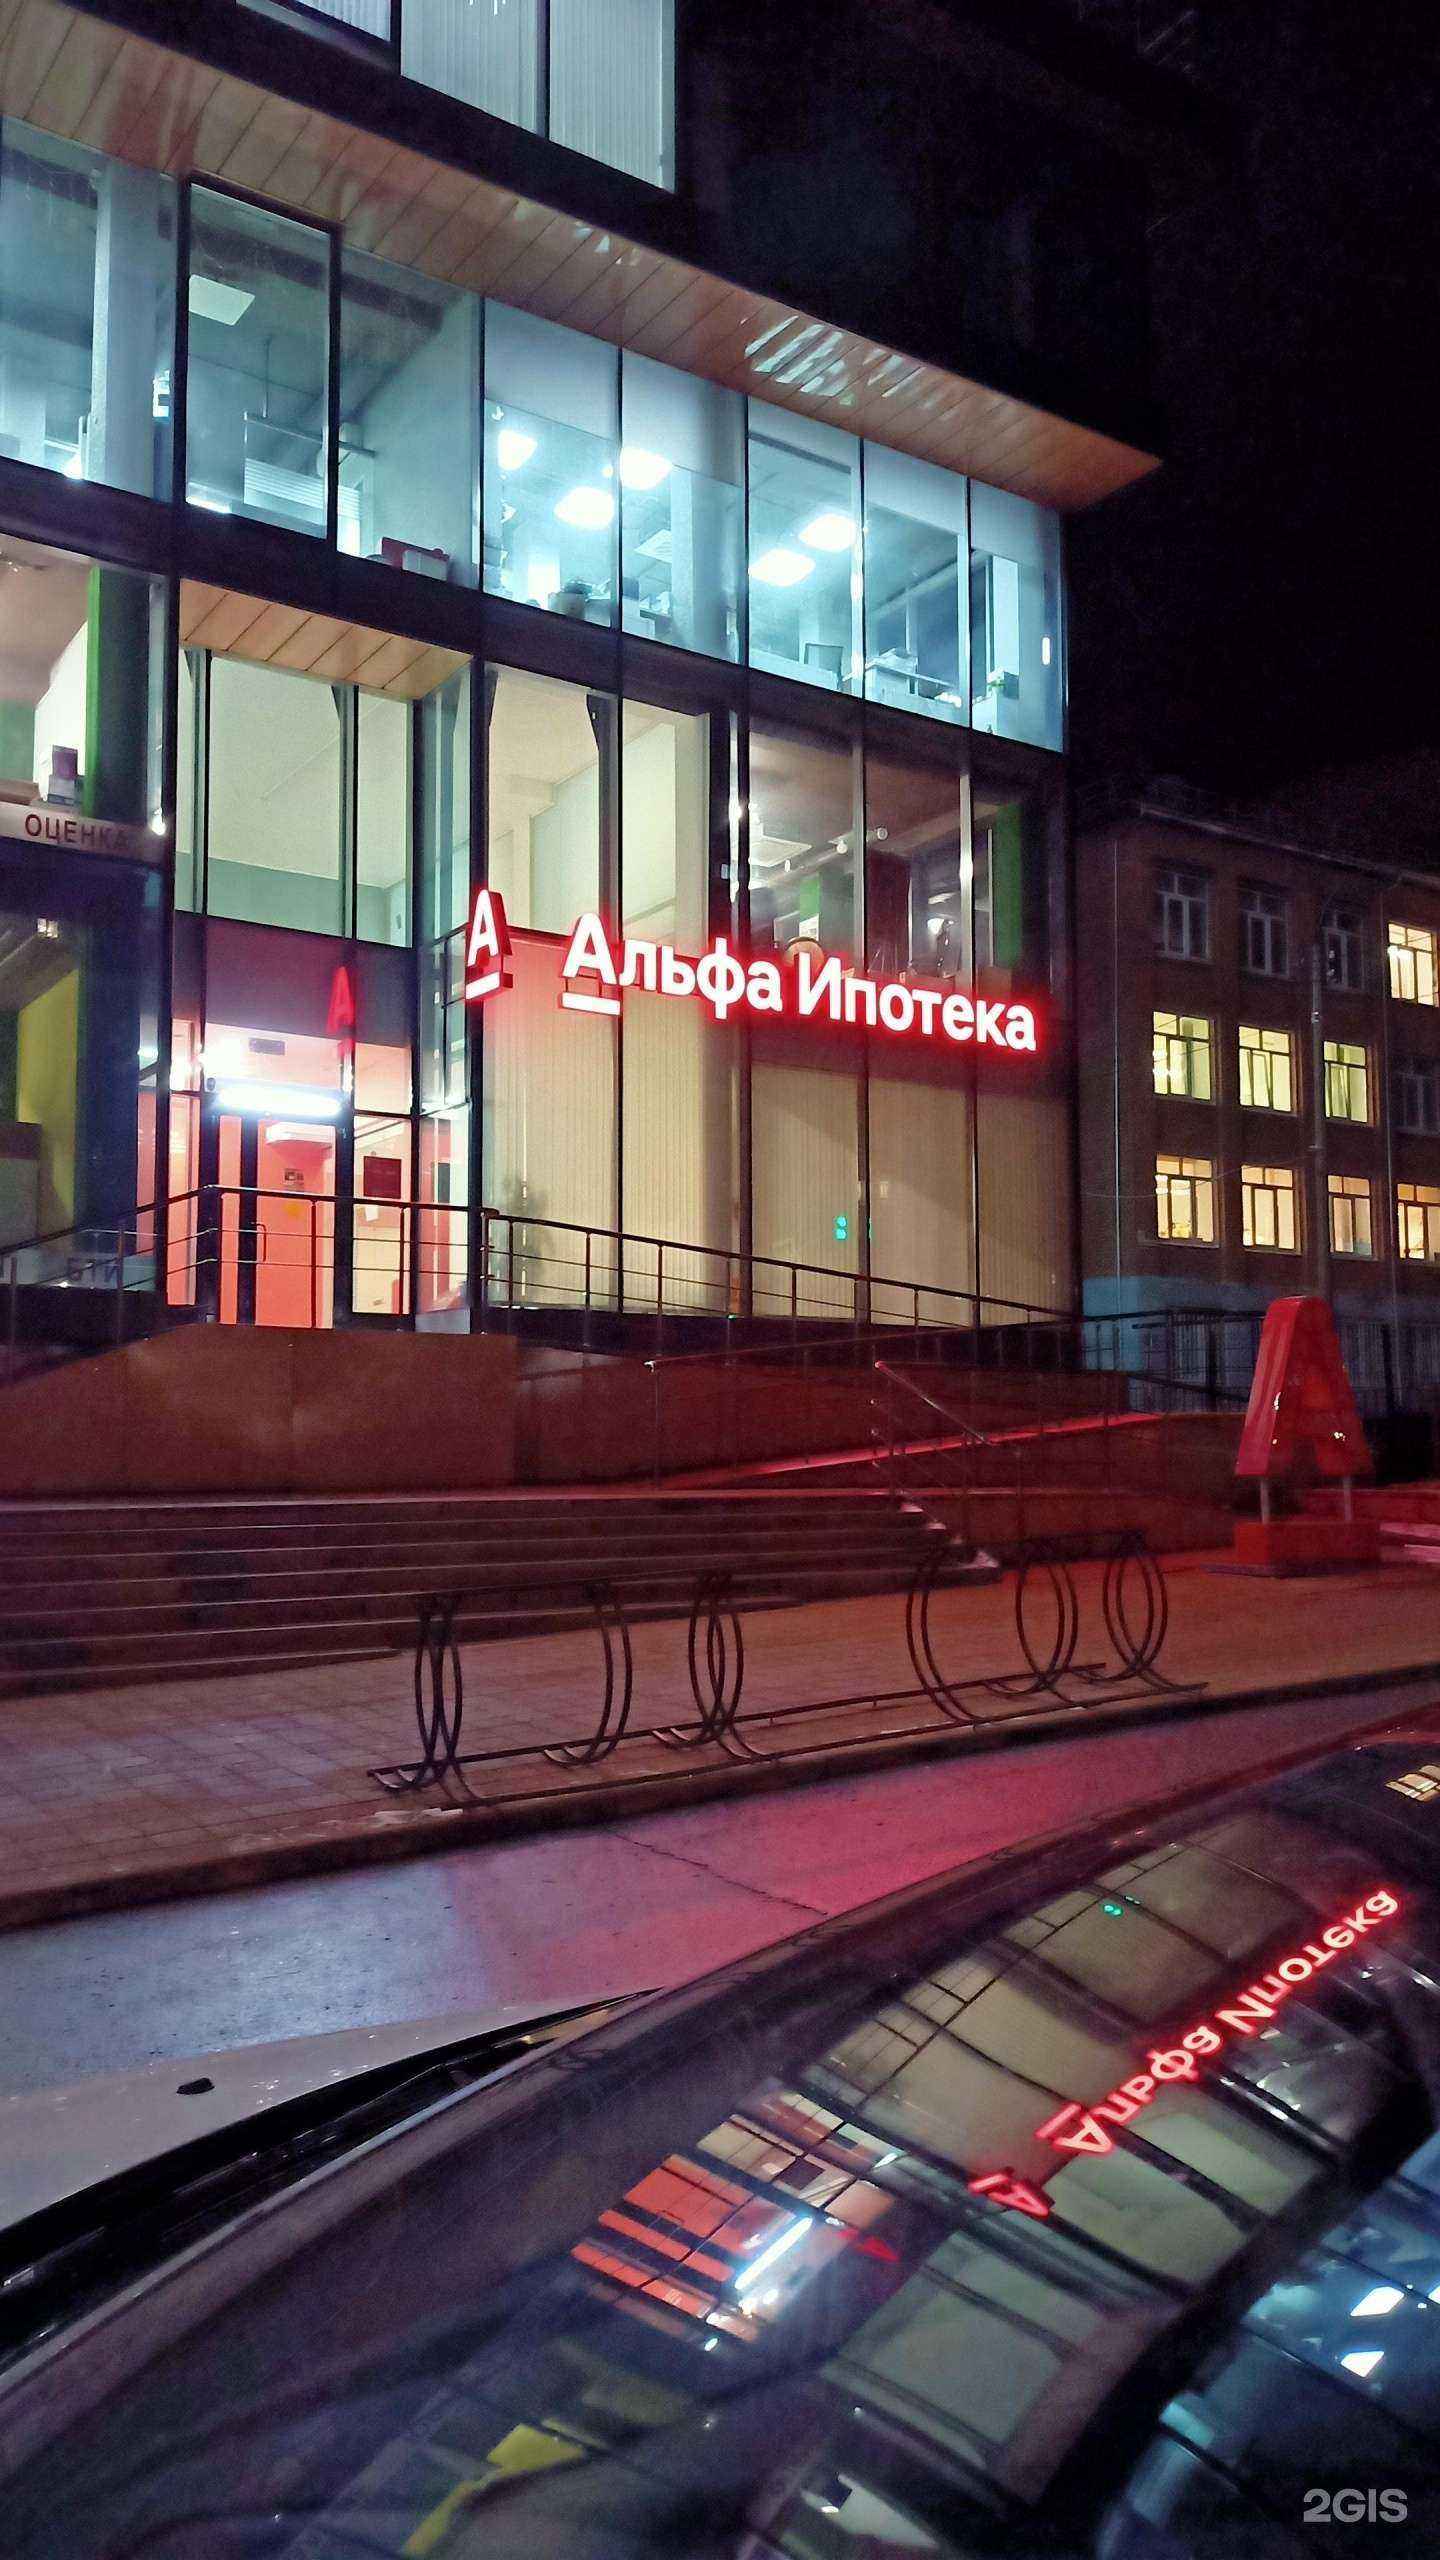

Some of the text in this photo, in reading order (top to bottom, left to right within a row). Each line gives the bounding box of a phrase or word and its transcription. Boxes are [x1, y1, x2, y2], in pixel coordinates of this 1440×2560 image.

[24, 813, 130, 850] ОЦЕНКА
[466, 888, 500, 967] А
[562, 911, 1038, 1053] Альфа Ипотека
